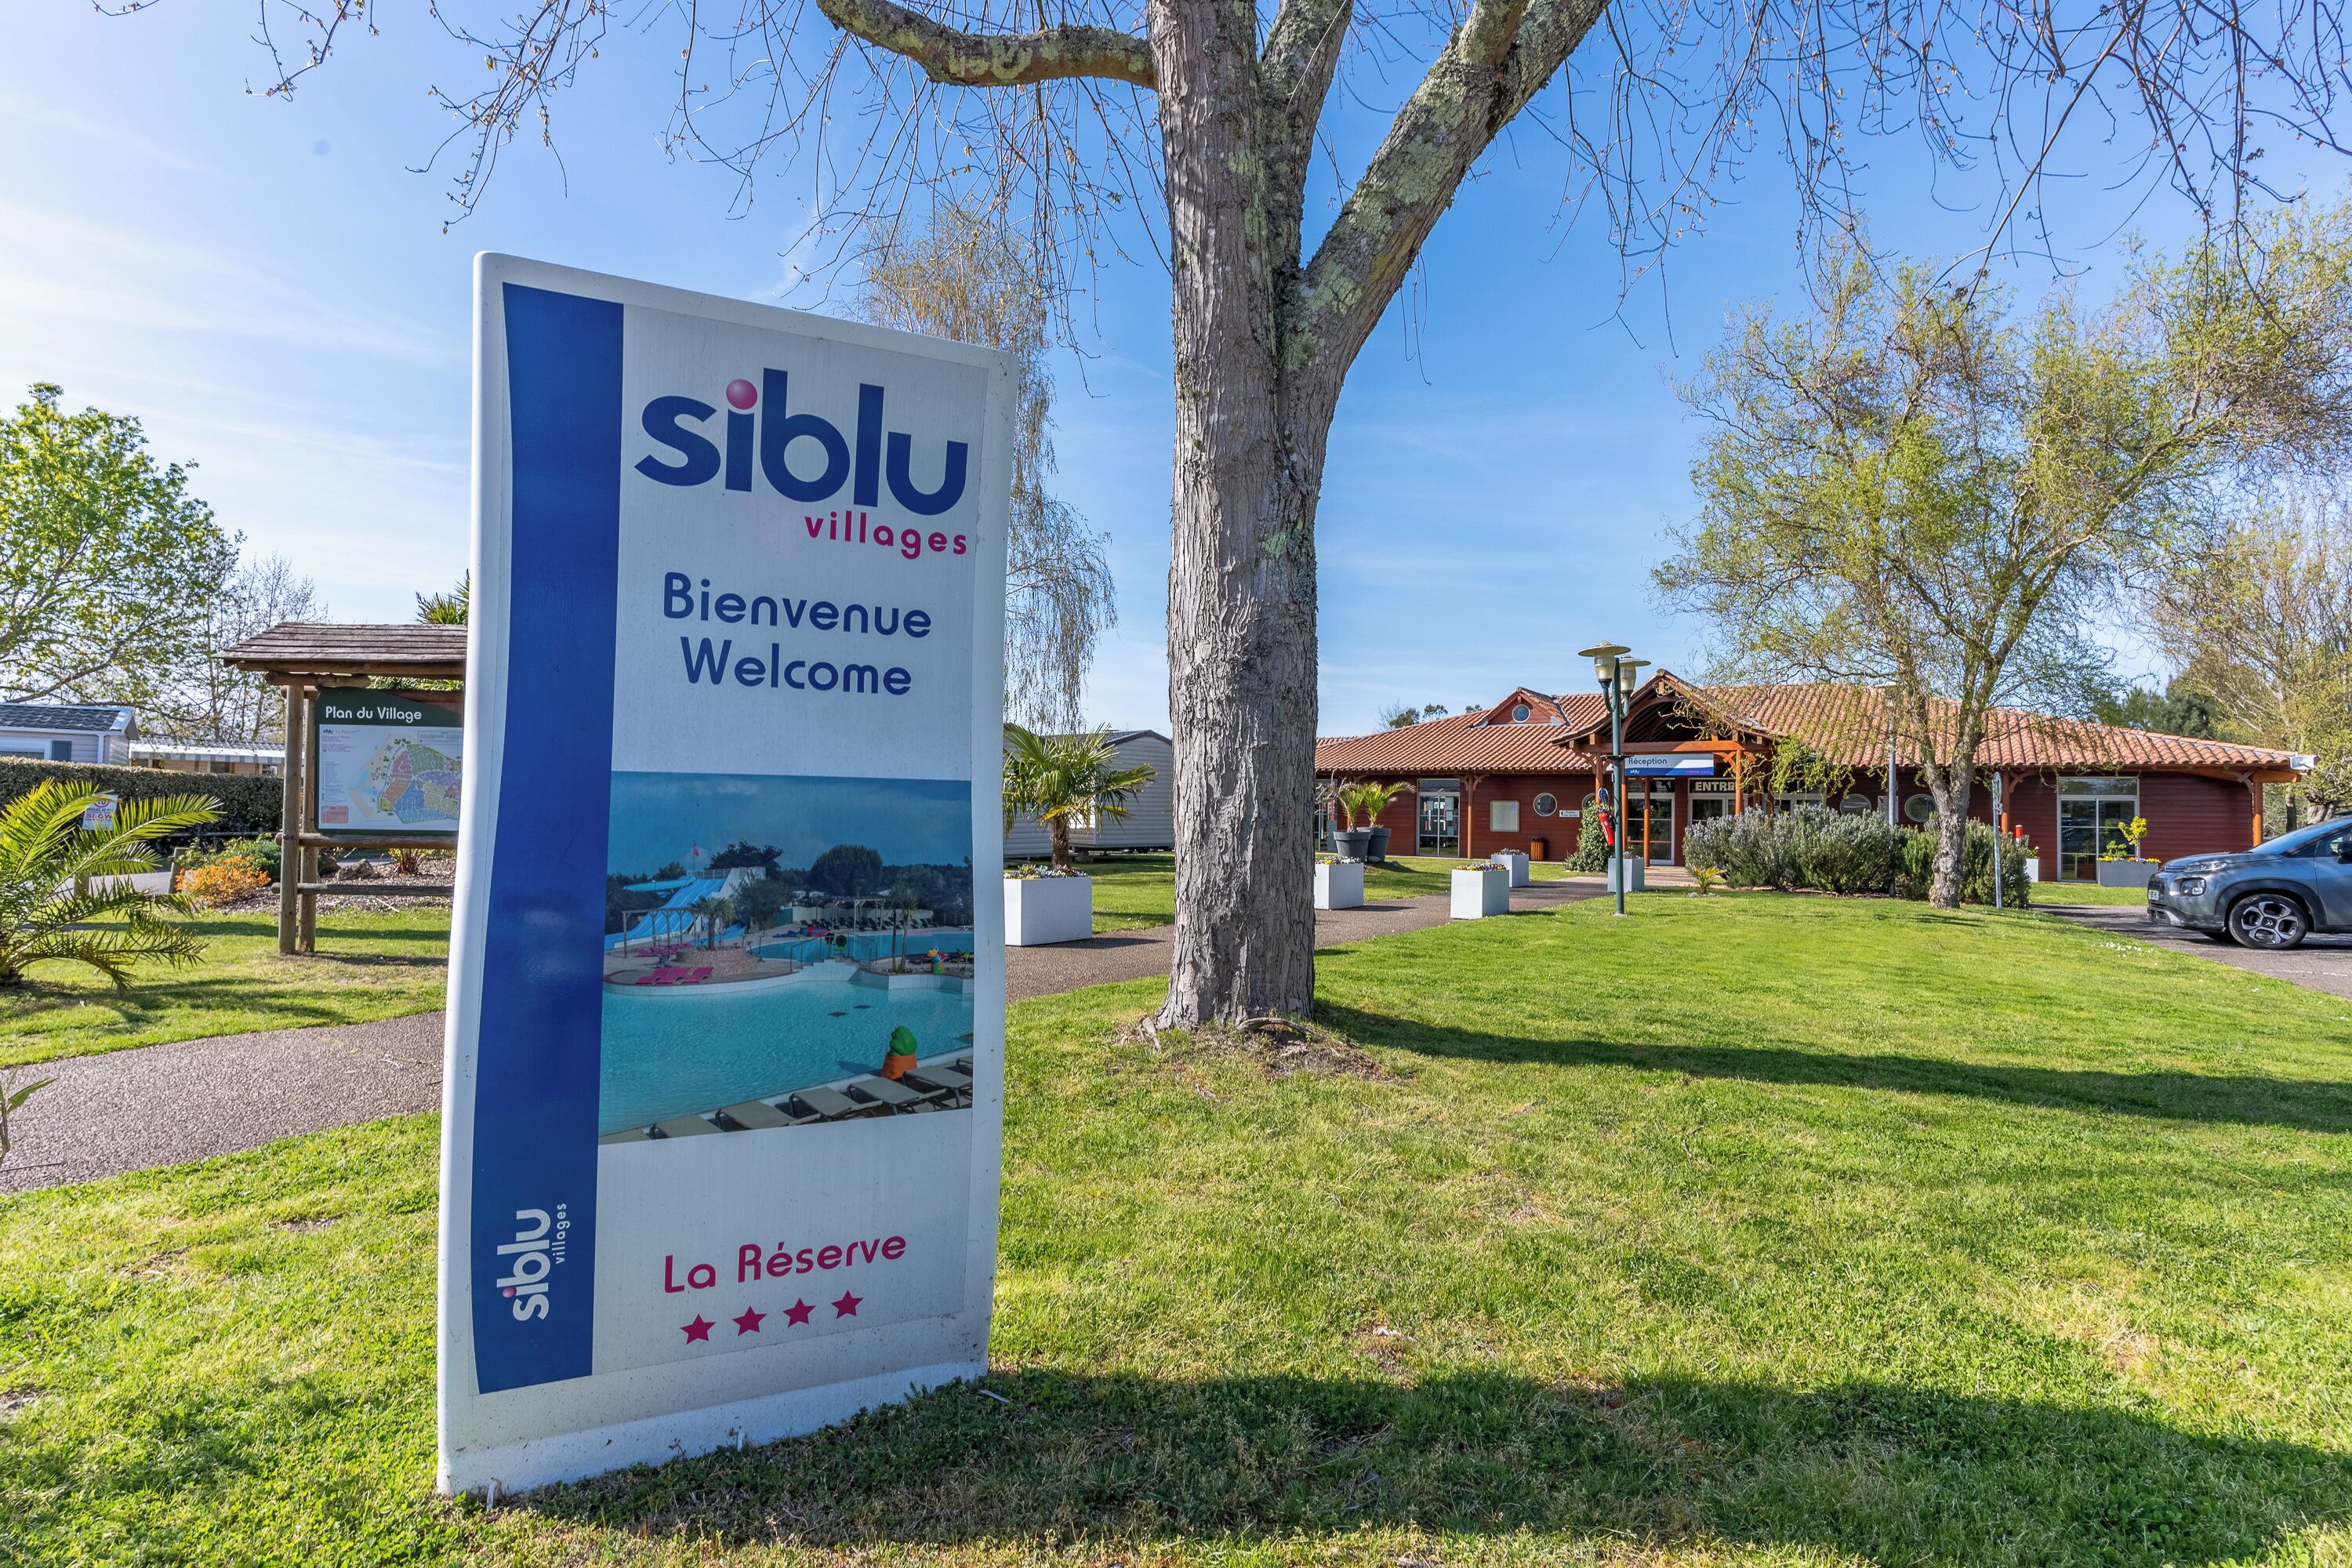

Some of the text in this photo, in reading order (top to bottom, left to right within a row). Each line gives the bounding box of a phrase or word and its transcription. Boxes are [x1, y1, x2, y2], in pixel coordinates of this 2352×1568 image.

[634, 367, 969, 517] siblu
[804, 510, 967, 560] villages
[663, 572, 932, 638] Bienvenue
[680, 637, 913, 696] Welcome
[325, 706, 423, 724] Plan du Village
[1628, 757, 1668, 767] Réception
[1695, 781, 1735, 791] ENTRE
[552, 1203, 571, 1265] villages
[496, 1208, 551, 1321] siblu
[664, 1236, 907, 1294] La Réserve
